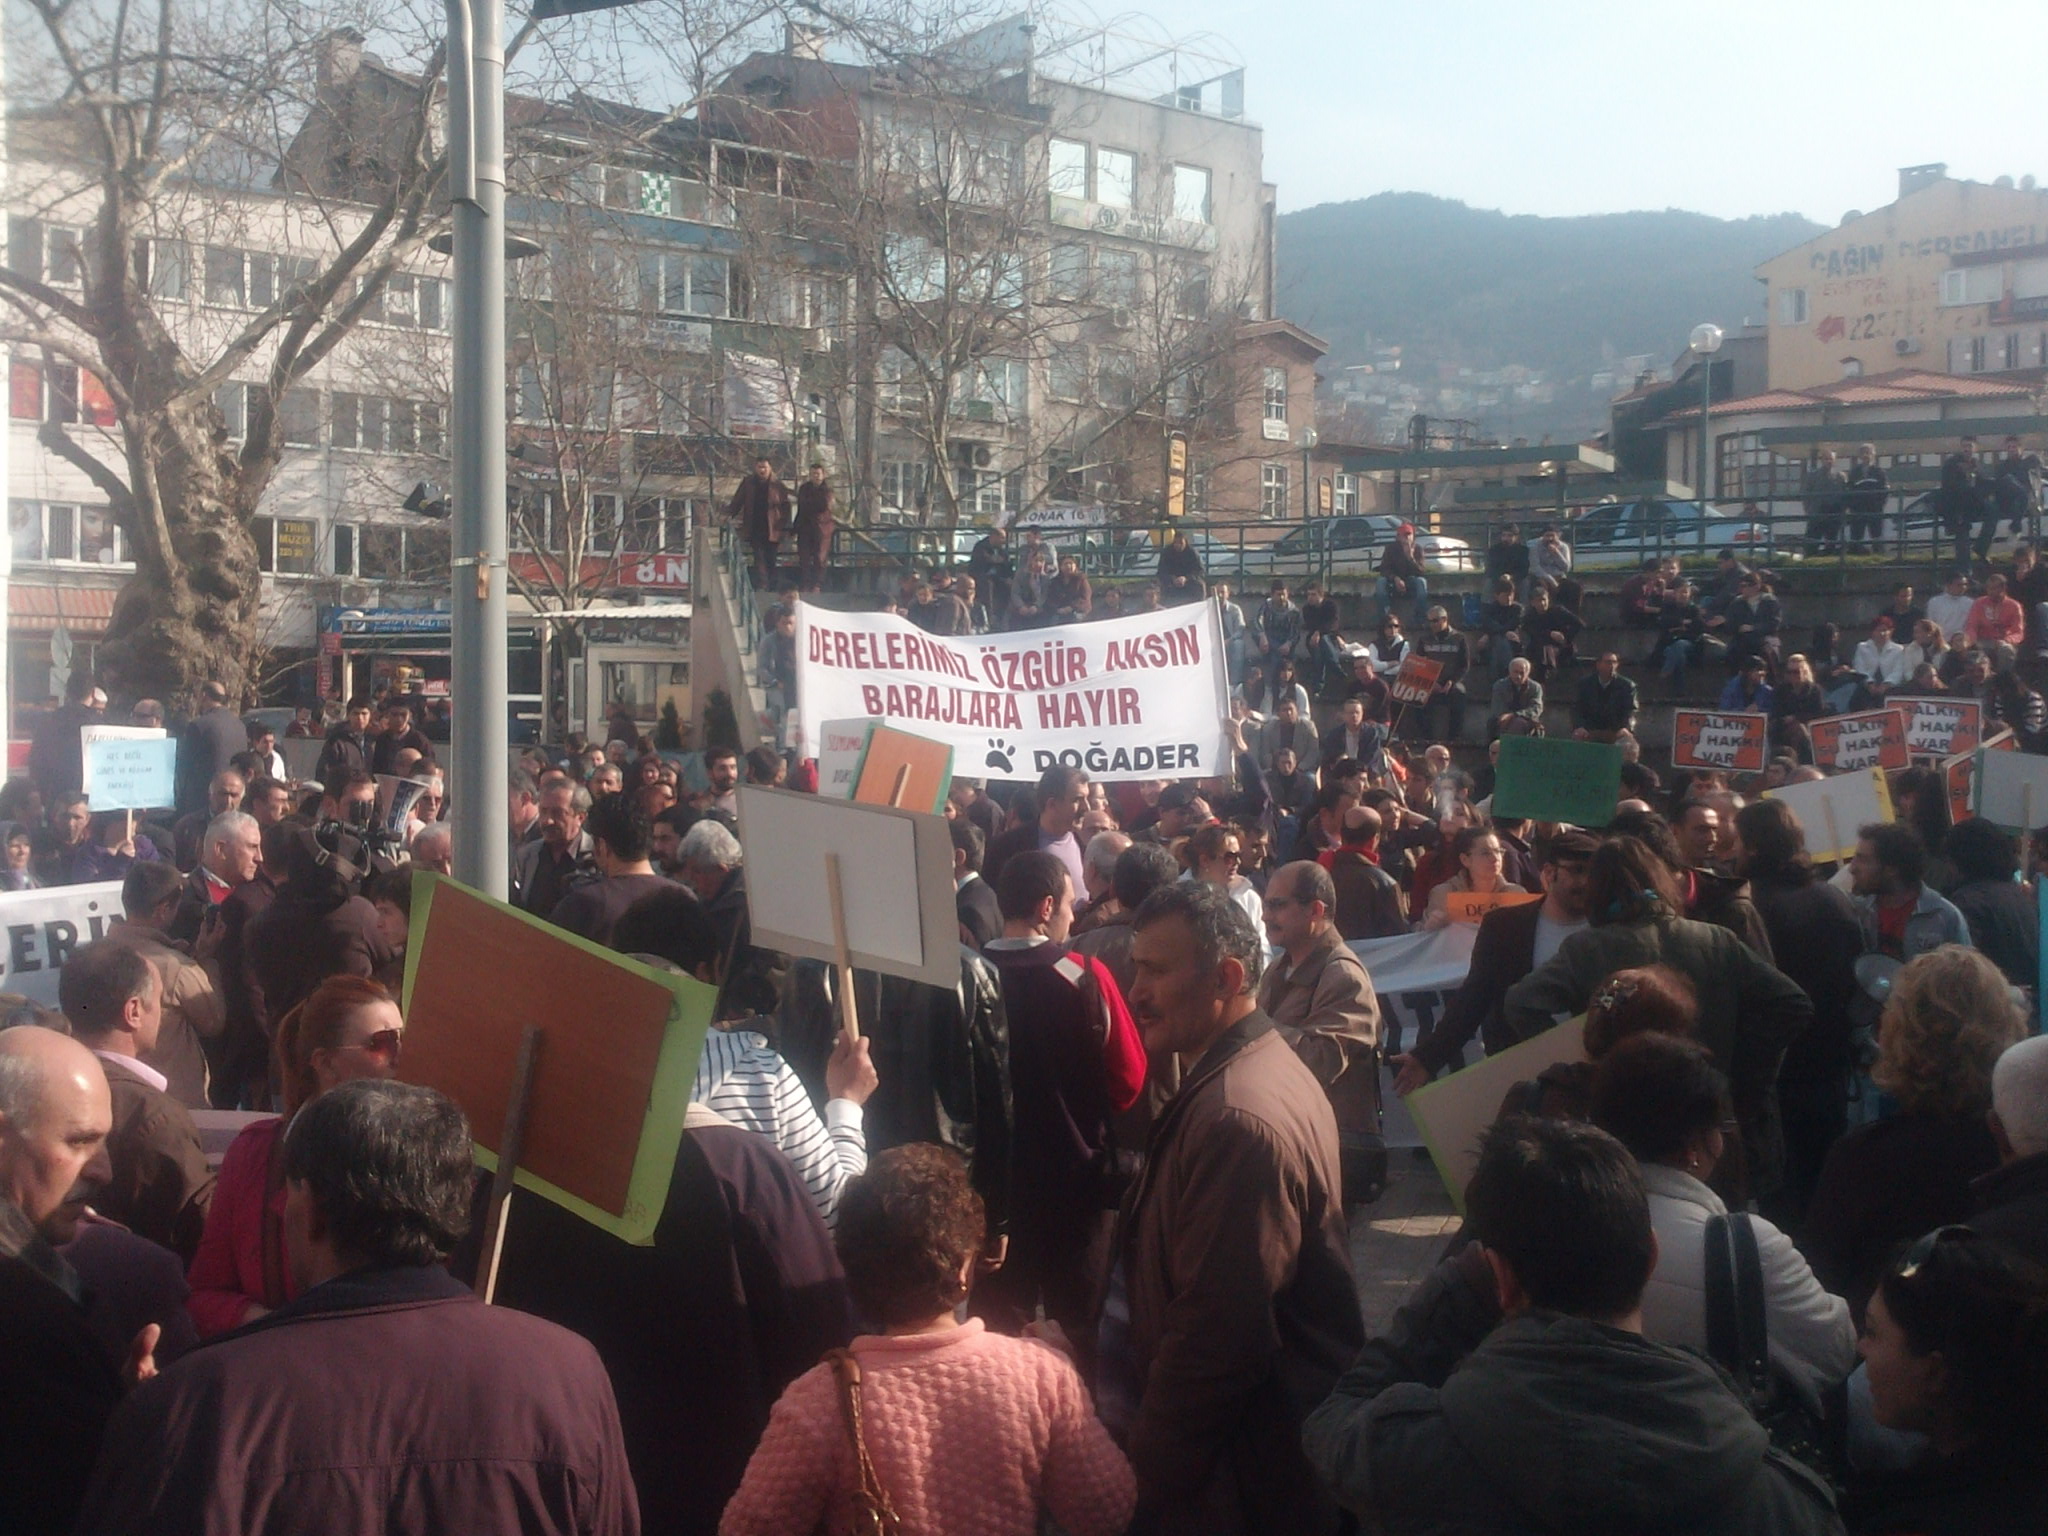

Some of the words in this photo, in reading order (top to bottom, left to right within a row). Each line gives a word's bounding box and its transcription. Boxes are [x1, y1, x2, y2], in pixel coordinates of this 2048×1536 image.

[808, 624, 978, 683] DERELERİMİZ
[979, 640, 1088, 690] ÖZGÜR
[1105, 624, 1201, 672] AKSIN
[862, 684, 1023, 730] BARAJLARA
[1037, 687, 1142, 729] HAYIR
[1689, 717, 1752, 731] HALKIN
[1707, 735, 1762, 748] HAKKI
[1915, 737, 1951, 750] VAR
[1033, 741, 1201, 773] DOĞADER
[1702, 752, 1736, 764] VAR
[1845, 758, 1882, 773] VAR
[0, 901, 126, 974] ERİ
